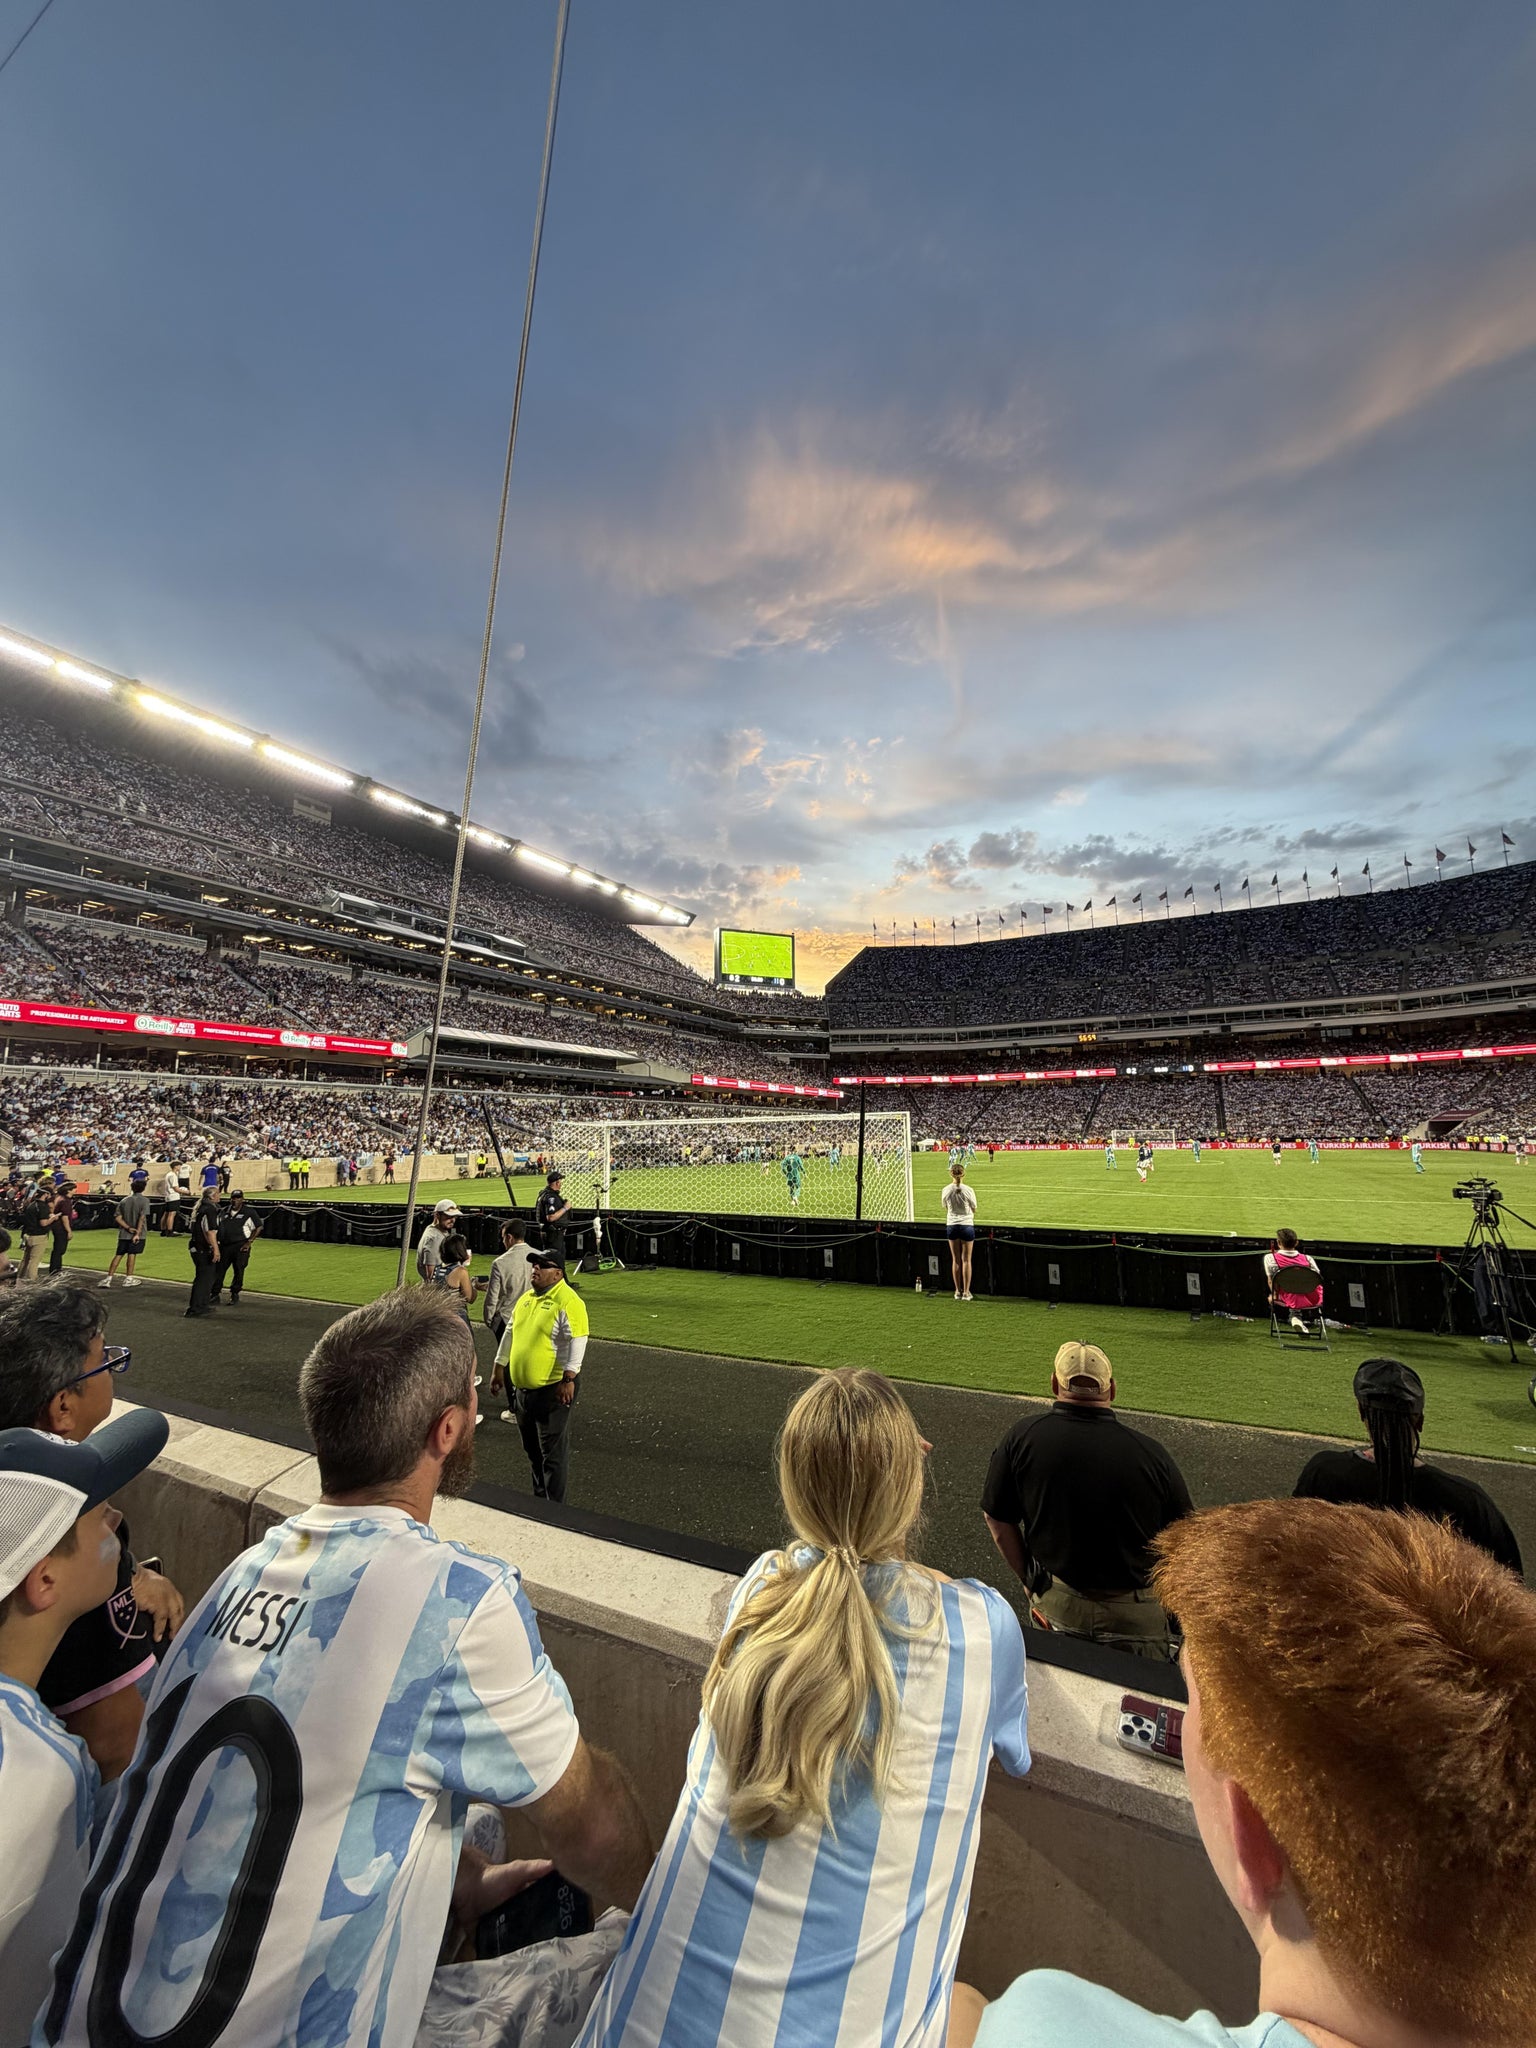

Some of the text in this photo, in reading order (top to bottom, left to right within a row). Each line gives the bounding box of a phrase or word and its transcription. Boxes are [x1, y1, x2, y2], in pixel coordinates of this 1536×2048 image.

[0, 1009, 21, 1018] ARTS
[30, 1010, 79, 1020] PROFESIONALES
[176, 1027, 196, 1035] PARTS
[204, 1584, 308, 1656] MESSI
[42, 1672, 304, 2048] 10
[557, 1884, 572, 1931] 8:26
